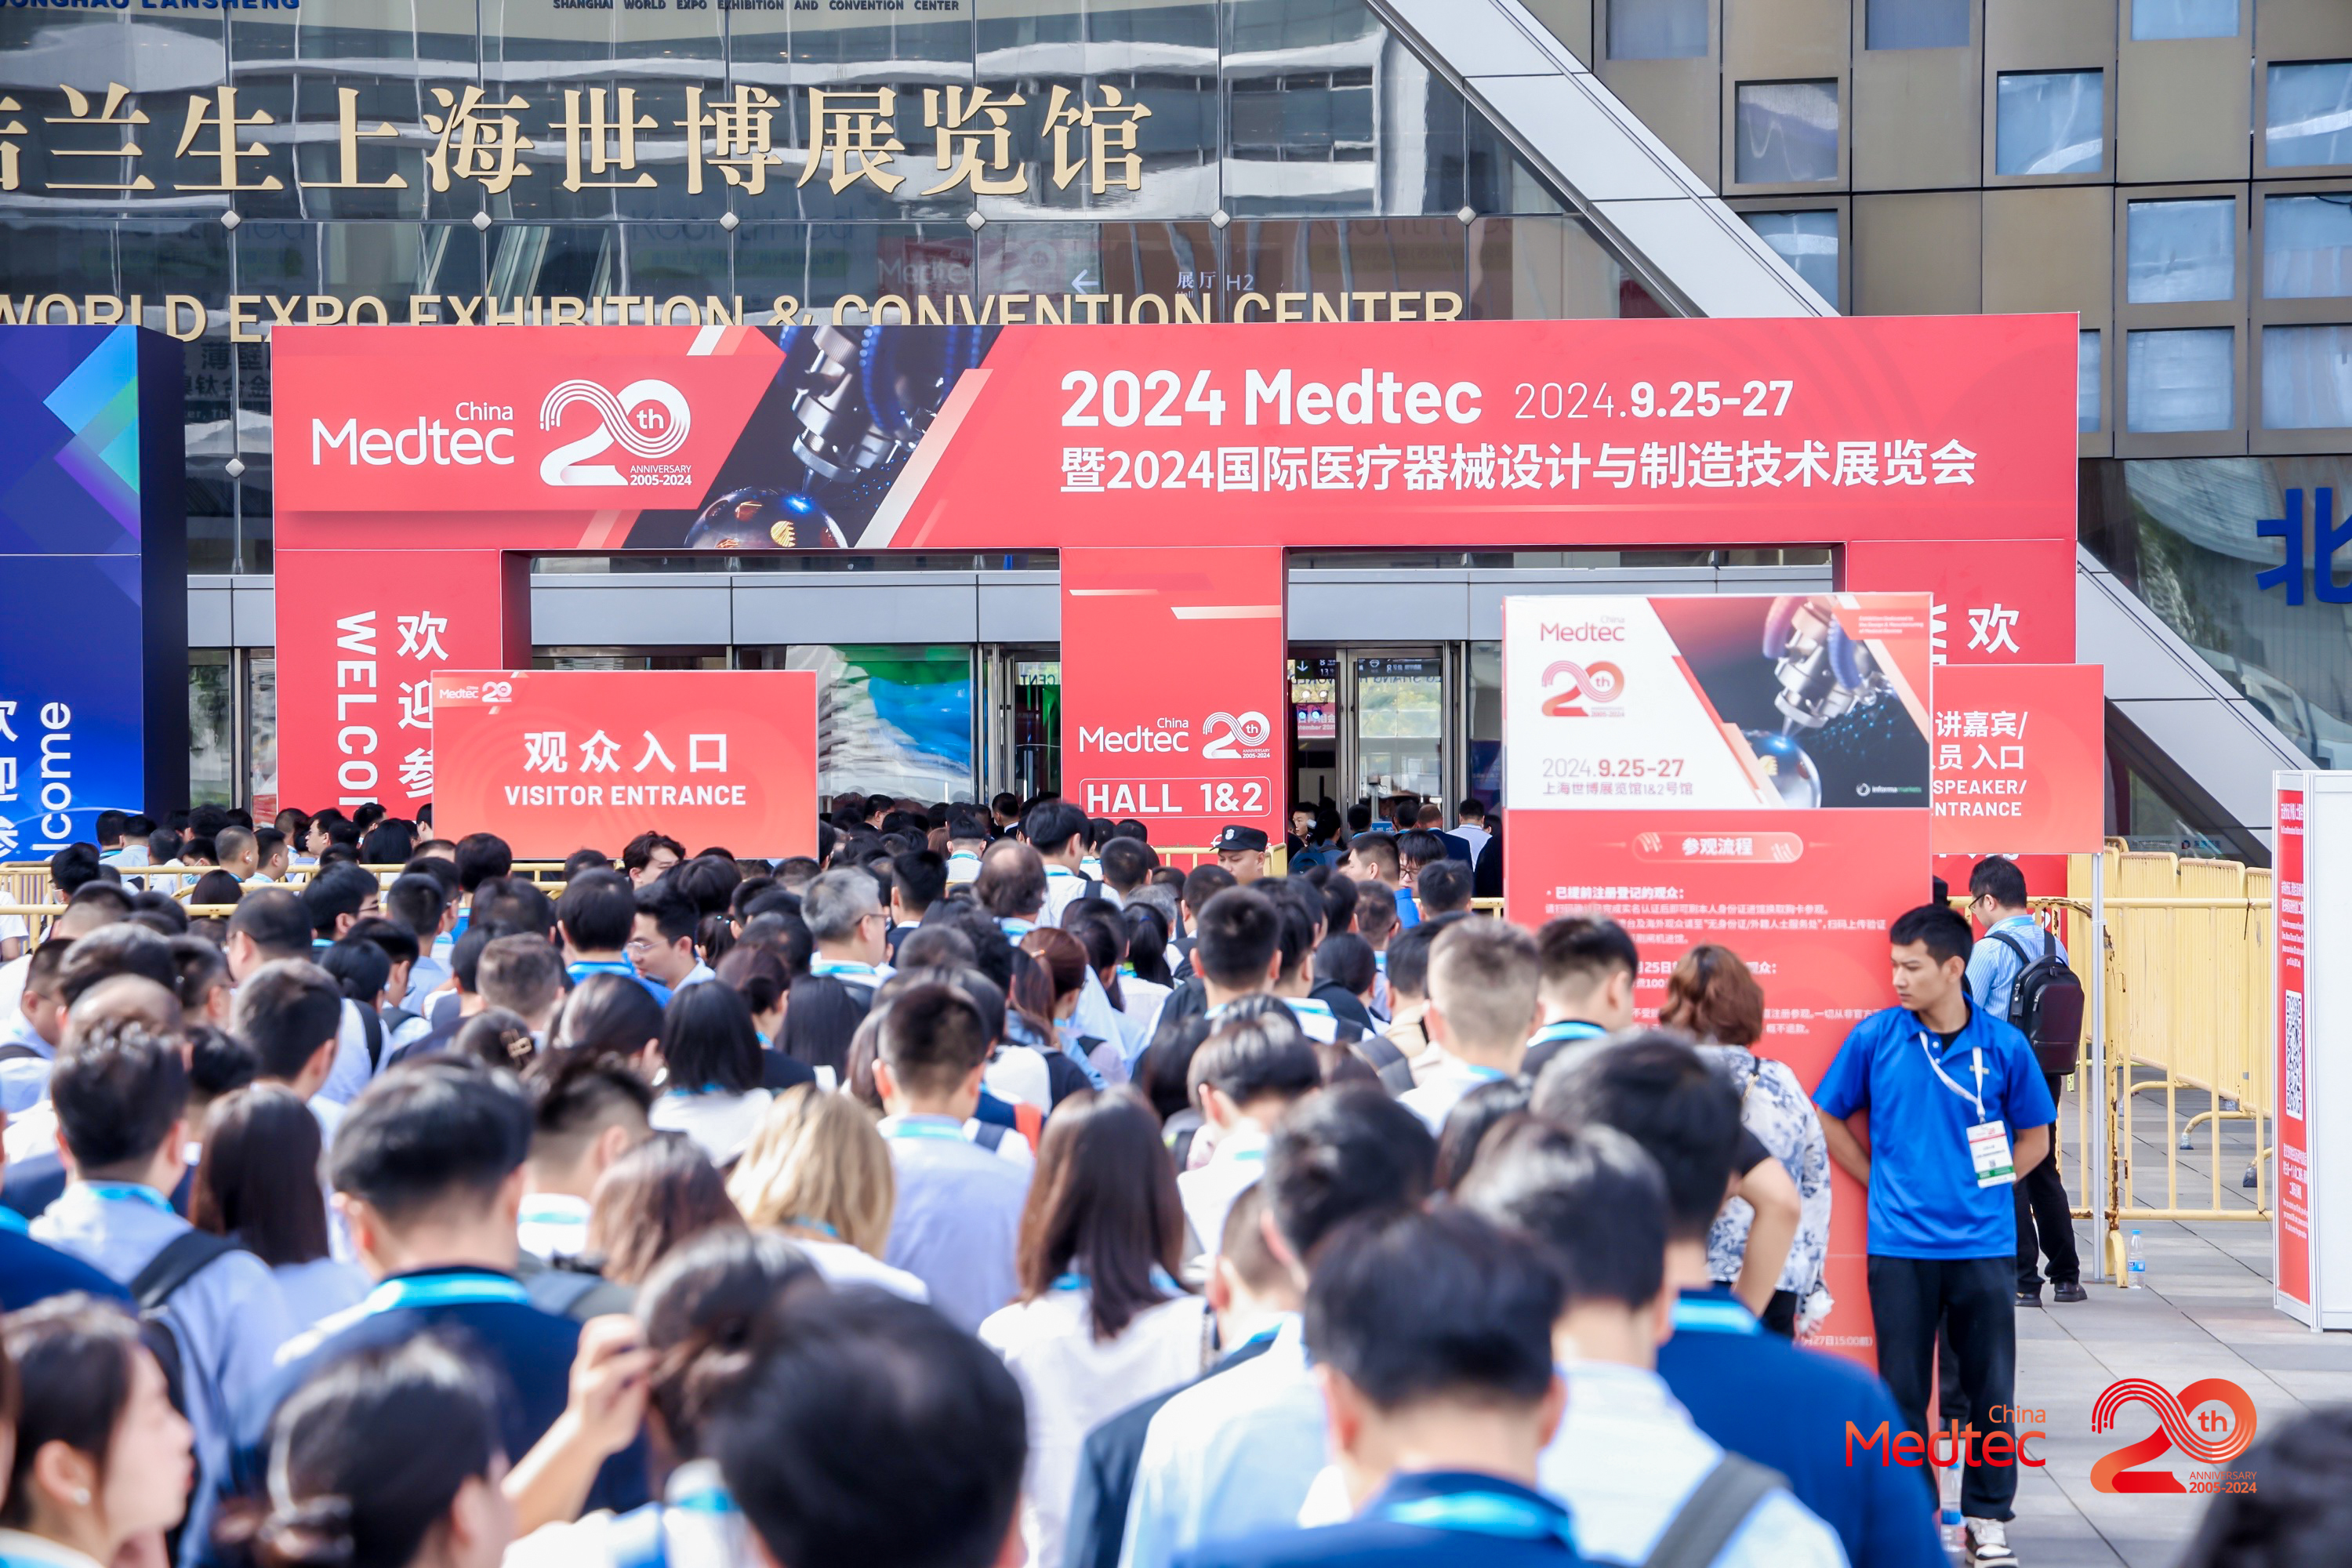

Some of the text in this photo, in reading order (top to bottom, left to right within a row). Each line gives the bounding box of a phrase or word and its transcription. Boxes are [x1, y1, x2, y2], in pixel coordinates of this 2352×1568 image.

[553, 0, 960, 10] SHANGHAI WORLD EXPO EXHIBITION AND CONVENTION CENTER
[0, 82, 1152, 195] 兰生上海世博展览馆
[1176, 272, 1254, 291] 展厅 H2
[230, 294, 389, 343] EXPO
[409, 295, 745, 325] EXHIBITION
[766, 294, 813, 325] &
[832, 293, 1211, 325] CONVENTION
[1233, 291, 1464, 323] CENTER
[1062, 368, 1794, 426] 2024 Medtec 2024.9.25-27
[456, 402, 514, 421] China
[312, 416, 515, 466] Medtec
[630, 465, 691, 474] ANNIVERSARY
[1061, 438, 1977, 492] 暨2024国际医疗器械设计与制造技术展览会
[630, 474, 691, 486] 2005-2024
[2256, 487, 2352, 606] 北
[1541, 622, 1625, 641] Medtec
[1967, 604, 2020, 654] 欢
[439, 688, 479, 699] Medtec
[336, 610, 379, 806] WELCO
[1157, 717, 1189, 729] China
[1934, 710, 2028, 740] 讲嘉宾/
[1079, 725, 1189, 753] Medtec
[524, 729, 728, 774] 观众入口
[1932, 744, 1963, 771] 员
[1543, 758, 1684, 779] 2024.9.25-27
[32, 702, 72, 860] lcome
[1543, 782, 1693, 796] 上海世博展览馆1&2号馆
[1933, 779, 2027, 795] SPEAKER/
[505, 785, 747, 806] VISITOR ENTRANCE
[1087, 782, 1263, 813] HALL 1&2
[1931, 801, 2022, 817] NTRANCE
[1682, 837, 1753, 856] 参观流程
